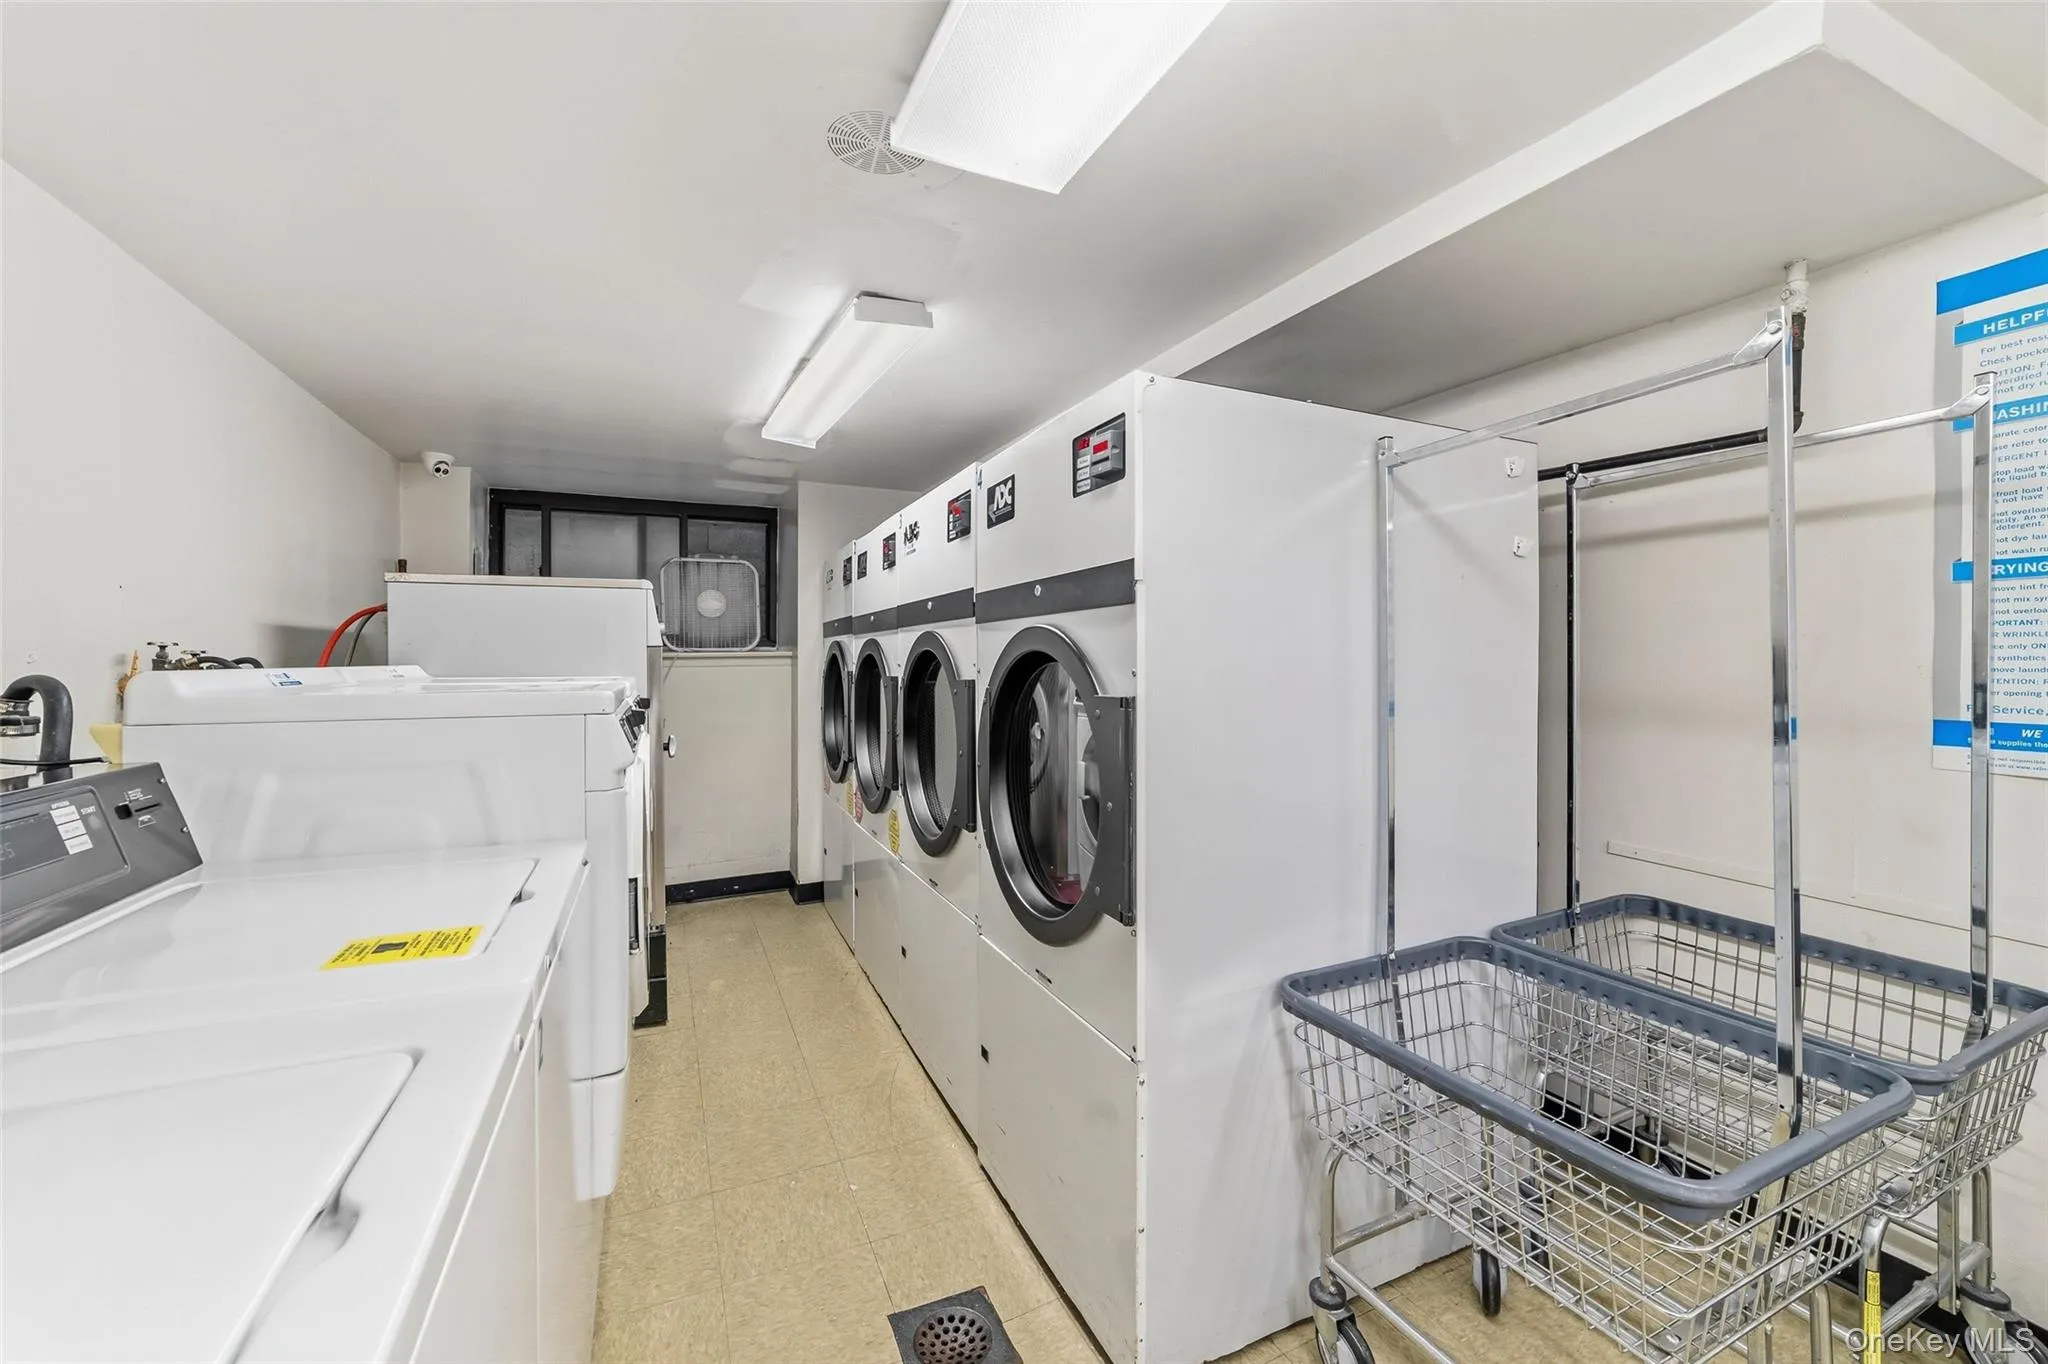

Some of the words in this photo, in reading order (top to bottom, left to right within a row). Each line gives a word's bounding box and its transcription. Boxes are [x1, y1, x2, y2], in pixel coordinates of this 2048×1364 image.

[1983, 309, 2048, 335] HELPF
[1981, 346, 1996, 355] For
[2001, 339, 2023, 350] best
[1980, 355, 2012, 367] Check
[2018, 382, 2036, 393] dry
[1993, 429, 2020, 439] arate
[1998, 451, 2040, 463] ERGENT
[2014, 465, 2035, 473] load
[2009, 471, 2037, 481] liquid
[1996, 489, 2018, 498] front
[2021, 486, 2043, 494] load
[2002, 496, 2018, 504] not
[1996, 521, 2045, 531] detergent.
[2011, 535, 2029, 543] dye
[1993, 561, 2048, 575] RYING
[2003, 690, 2042, 698] opening
[2021, 728, 2043, 739] WE
